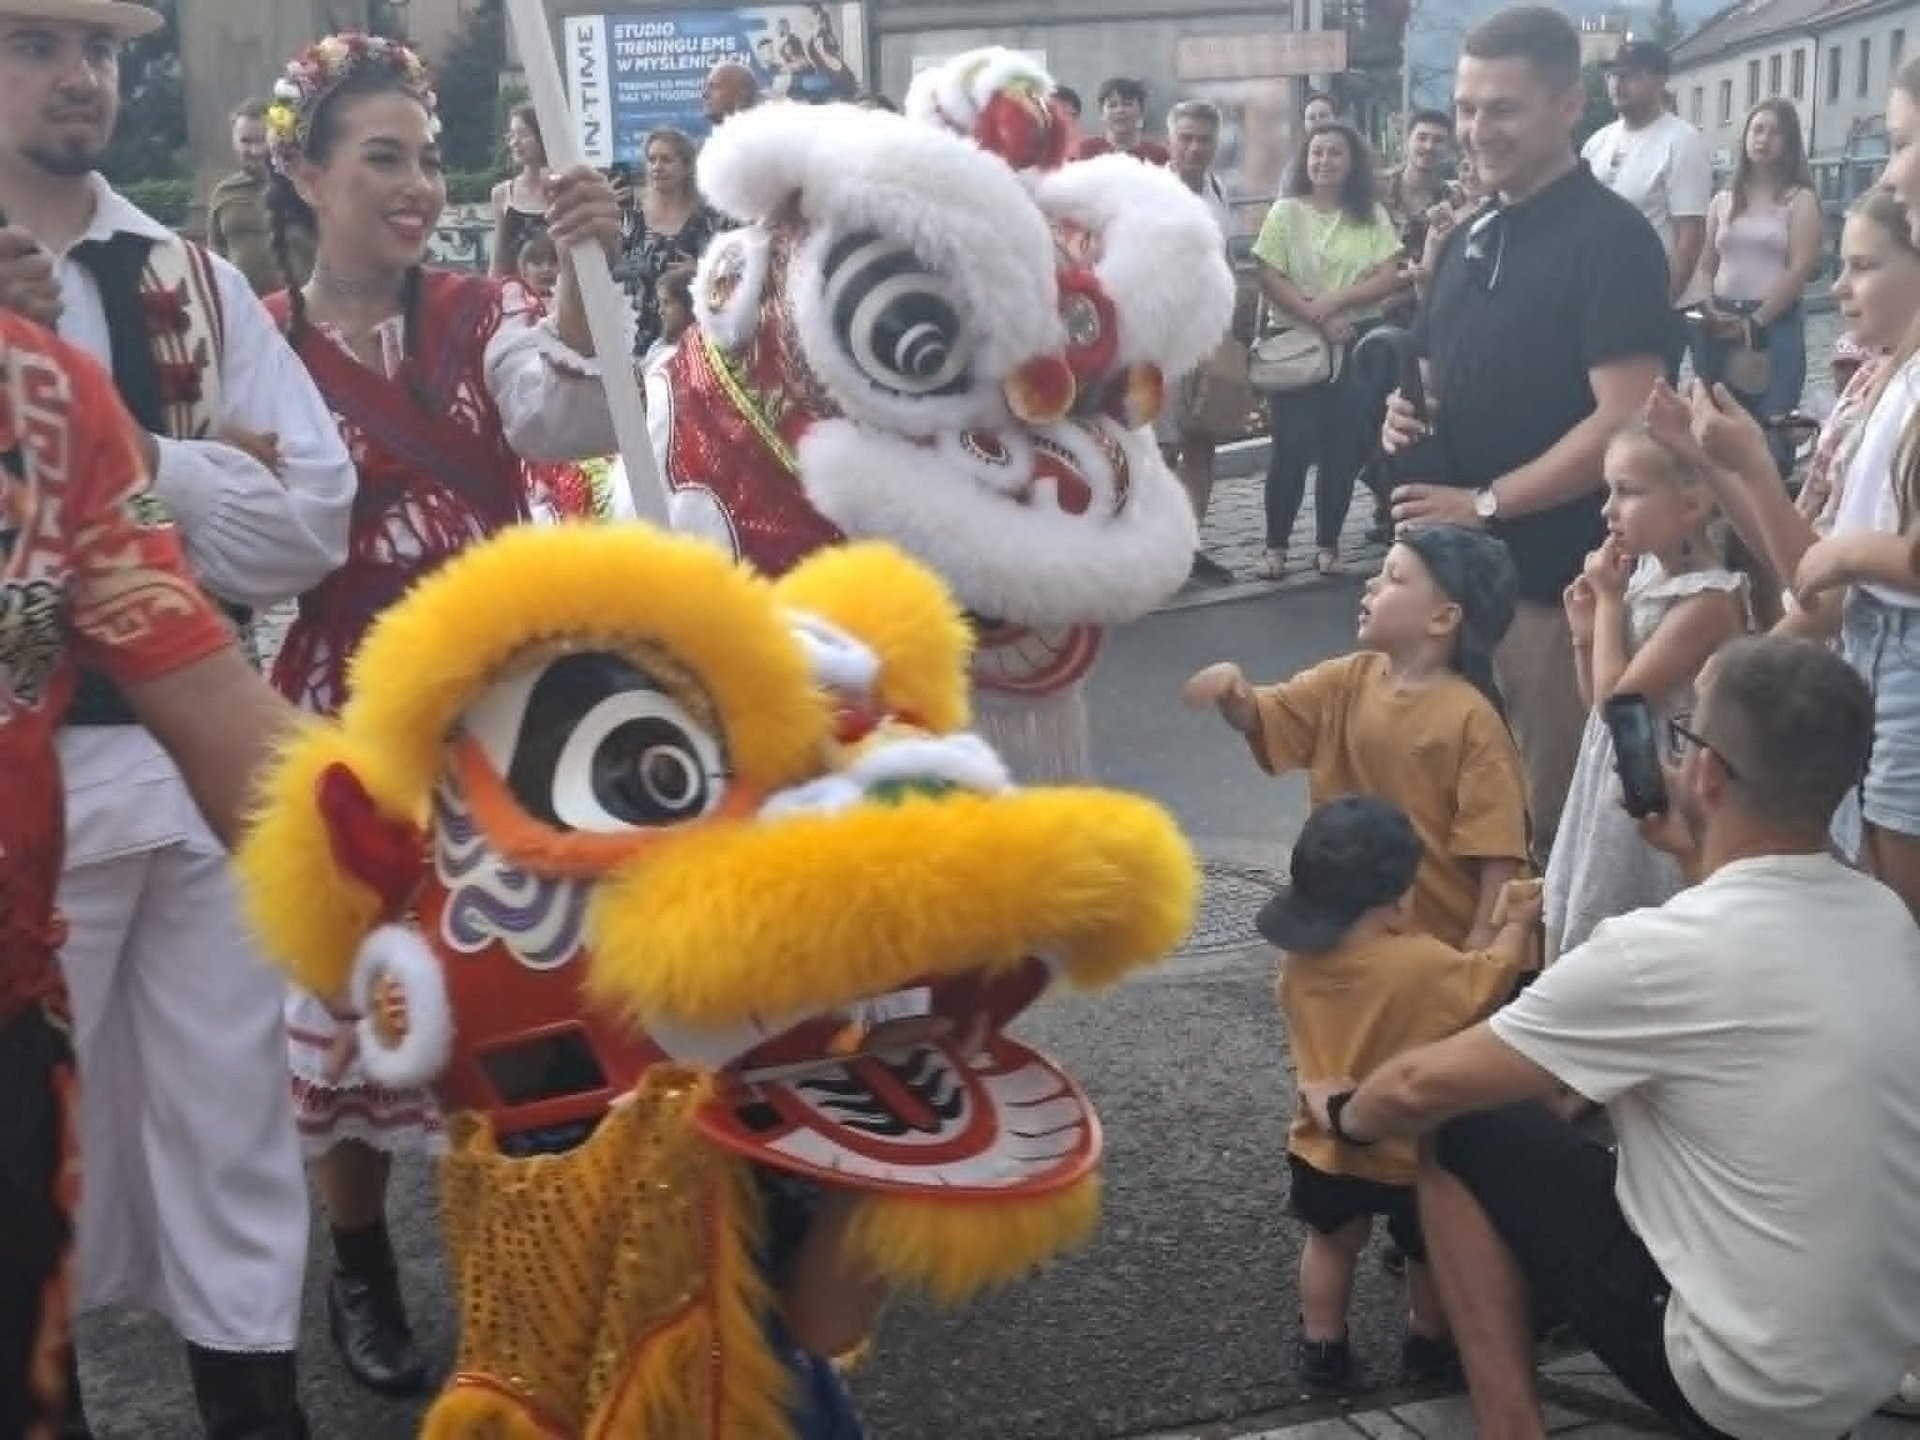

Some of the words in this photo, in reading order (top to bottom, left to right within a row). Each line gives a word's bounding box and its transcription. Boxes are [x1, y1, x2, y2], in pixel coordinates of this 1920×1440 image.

[614, 22, 674, 40] STUDIO
[615, 37, 698, 56] TRENINGU
[701, 36, 736, 53] EMS
[616, 58, 633, 73] W
